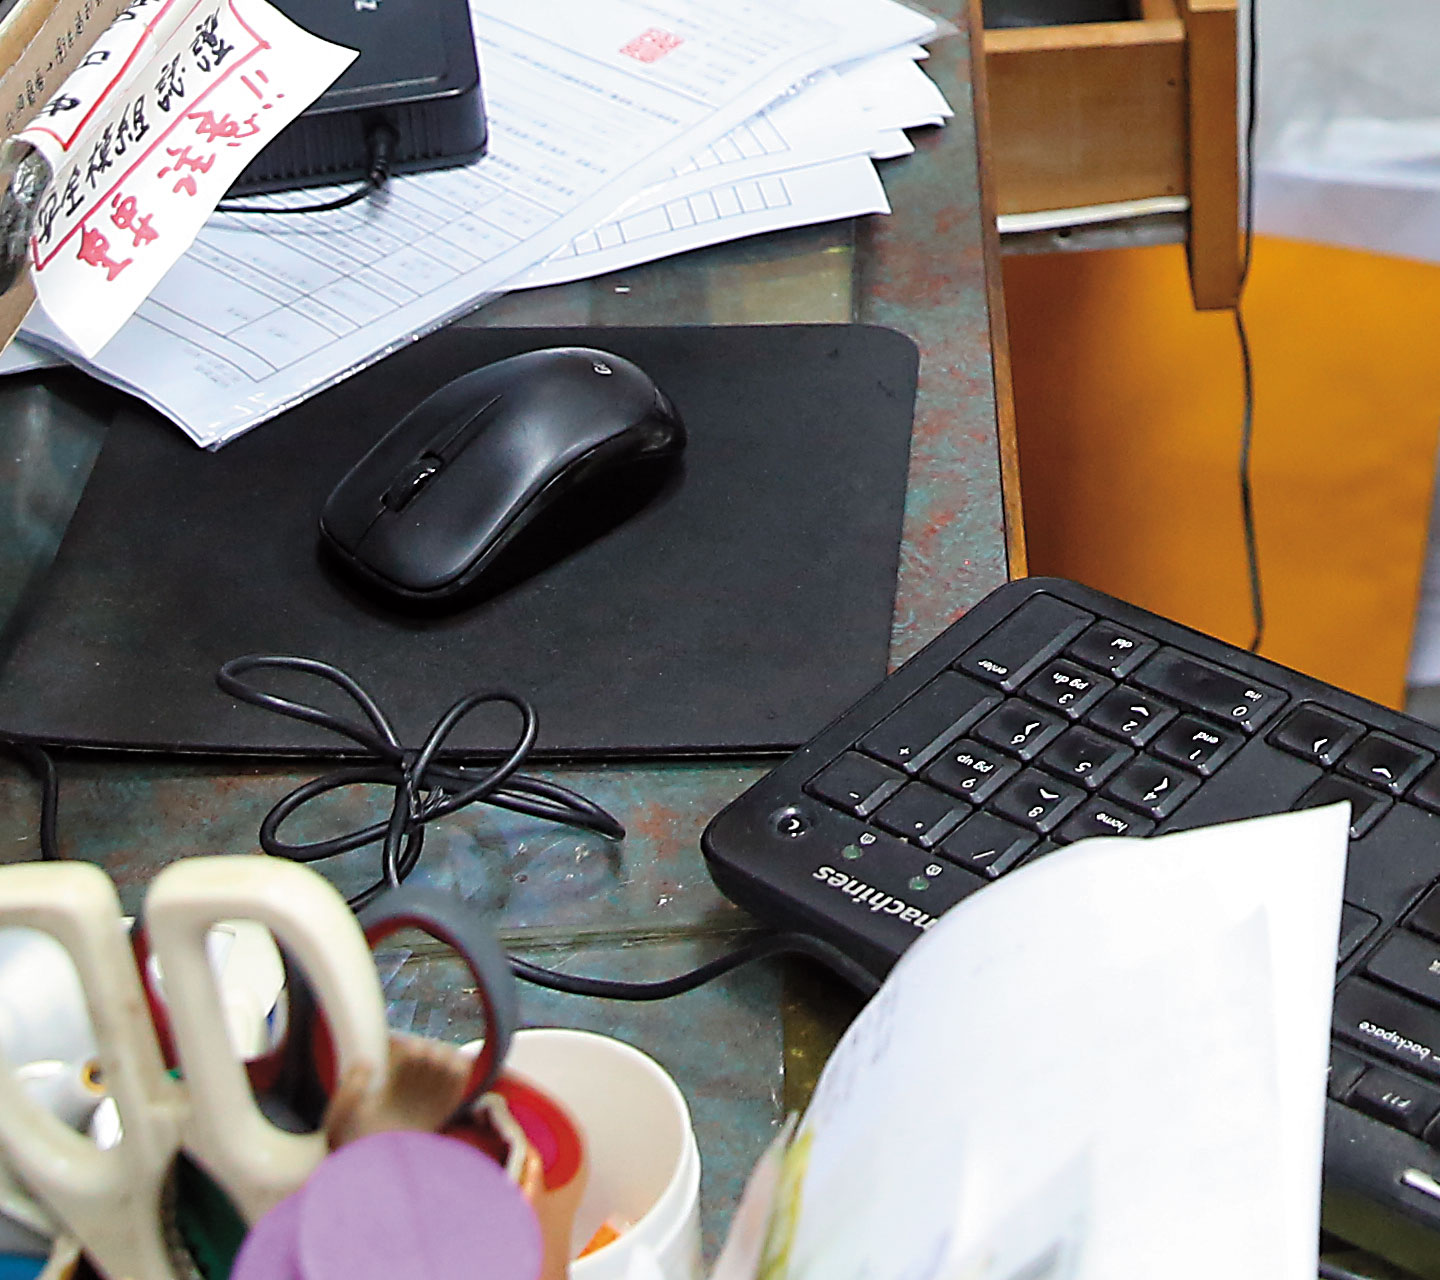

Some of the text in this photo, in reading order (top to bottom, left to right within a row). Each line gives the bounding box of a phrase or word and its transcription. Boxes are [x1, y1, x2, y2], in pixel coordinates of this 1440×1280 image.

[978, 660, 1007, 675] enter
[1058, 693, 1074, 704] 3
[1122, 720, 1138, 732] 2
[1192, 731, 1219, 744] end
[1074, 762, 1092, 773] 5
[961, 778, 977, 788] 9
[1142, 787, 1159, 801] 4
[1028, 806, 1044, 818] 8
[1096, 813, 1128, 833] home
[1359, 1021, 1431, 1061] backspace
